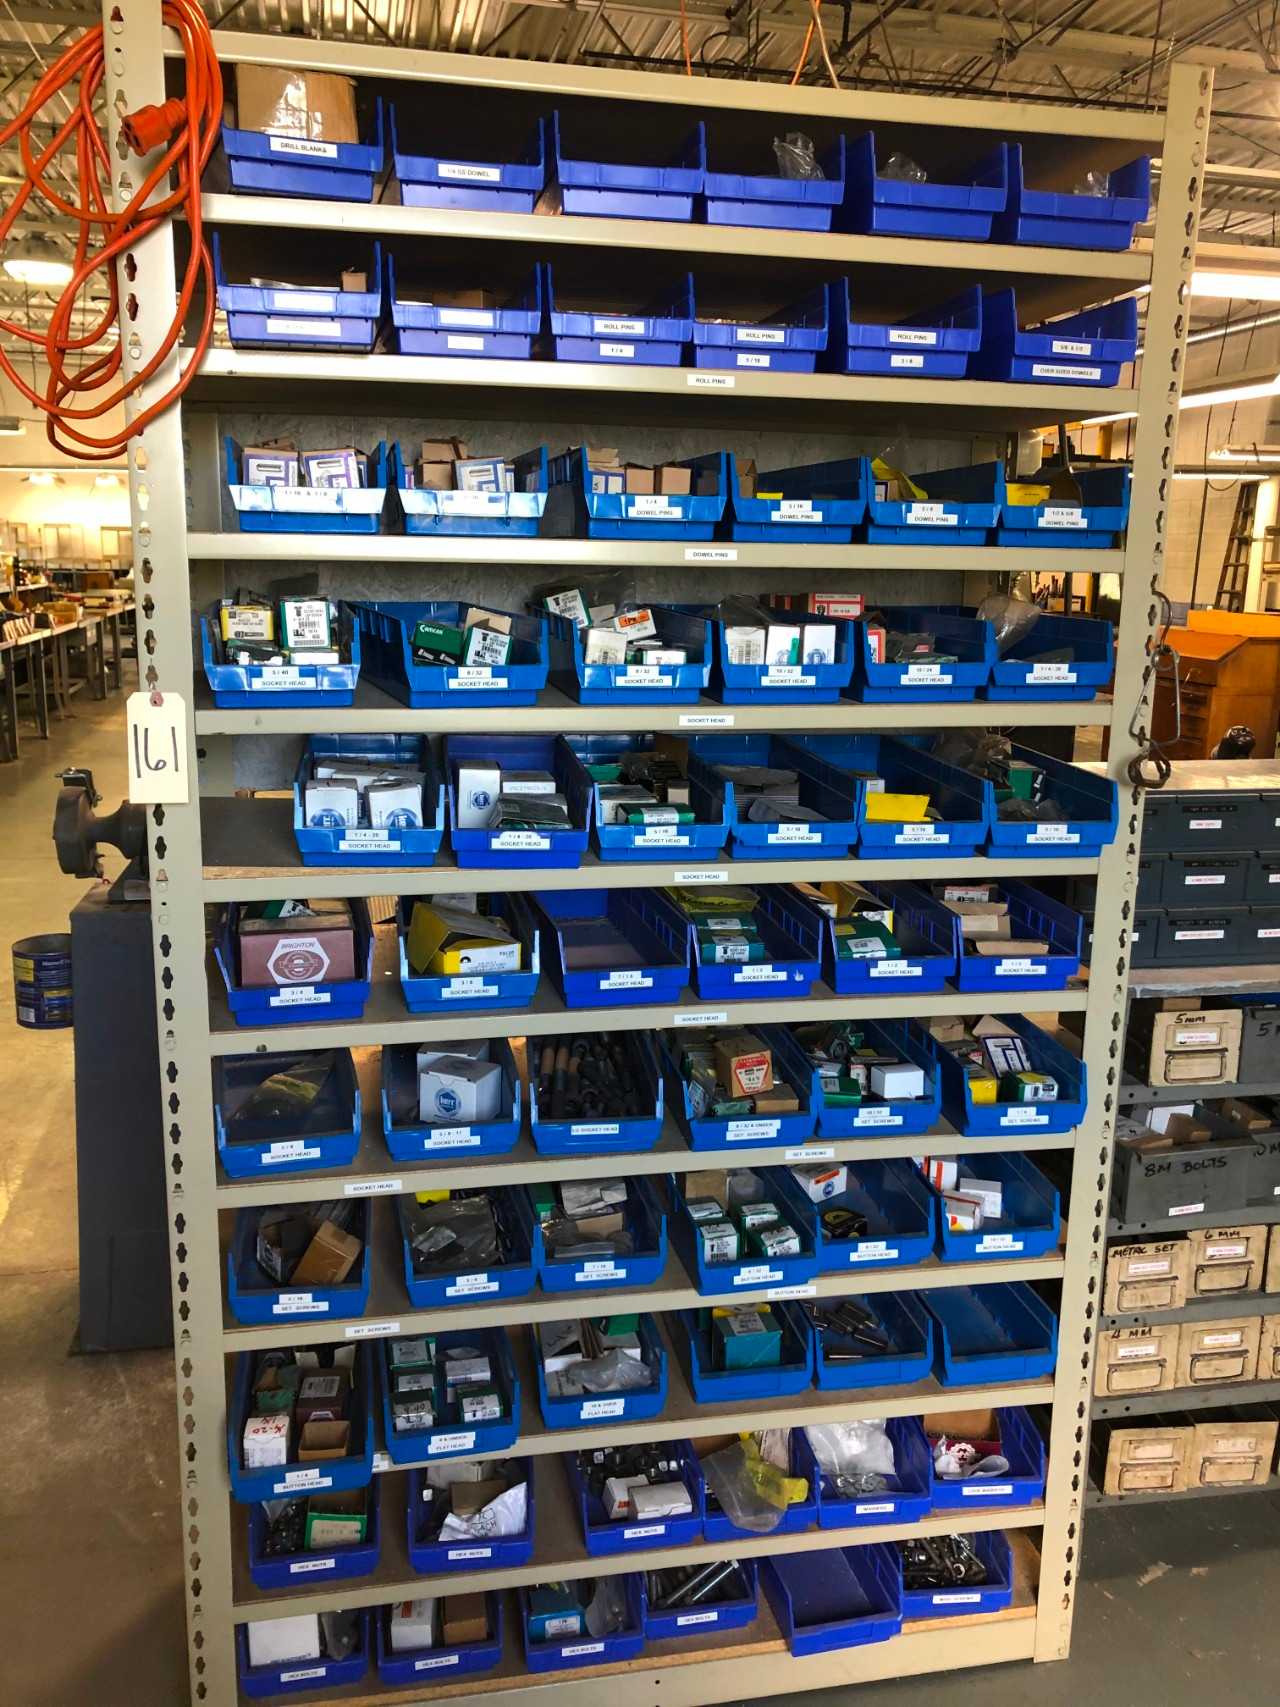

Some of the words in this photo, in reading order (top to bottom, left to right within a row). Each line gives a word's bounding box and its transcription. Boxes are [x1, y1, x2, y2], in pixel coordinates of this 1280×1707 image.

[134, 724, 178, 778] 161
[1257, 1022, 1272, 1037] 5
[1182, 1156, 1227, 1174] BOLTS
[353, 1184, 376, 1192] SOCKET
[1204, 1229, 1213, 1240] 6
[1155, 1243, 1177, 1253] SET
